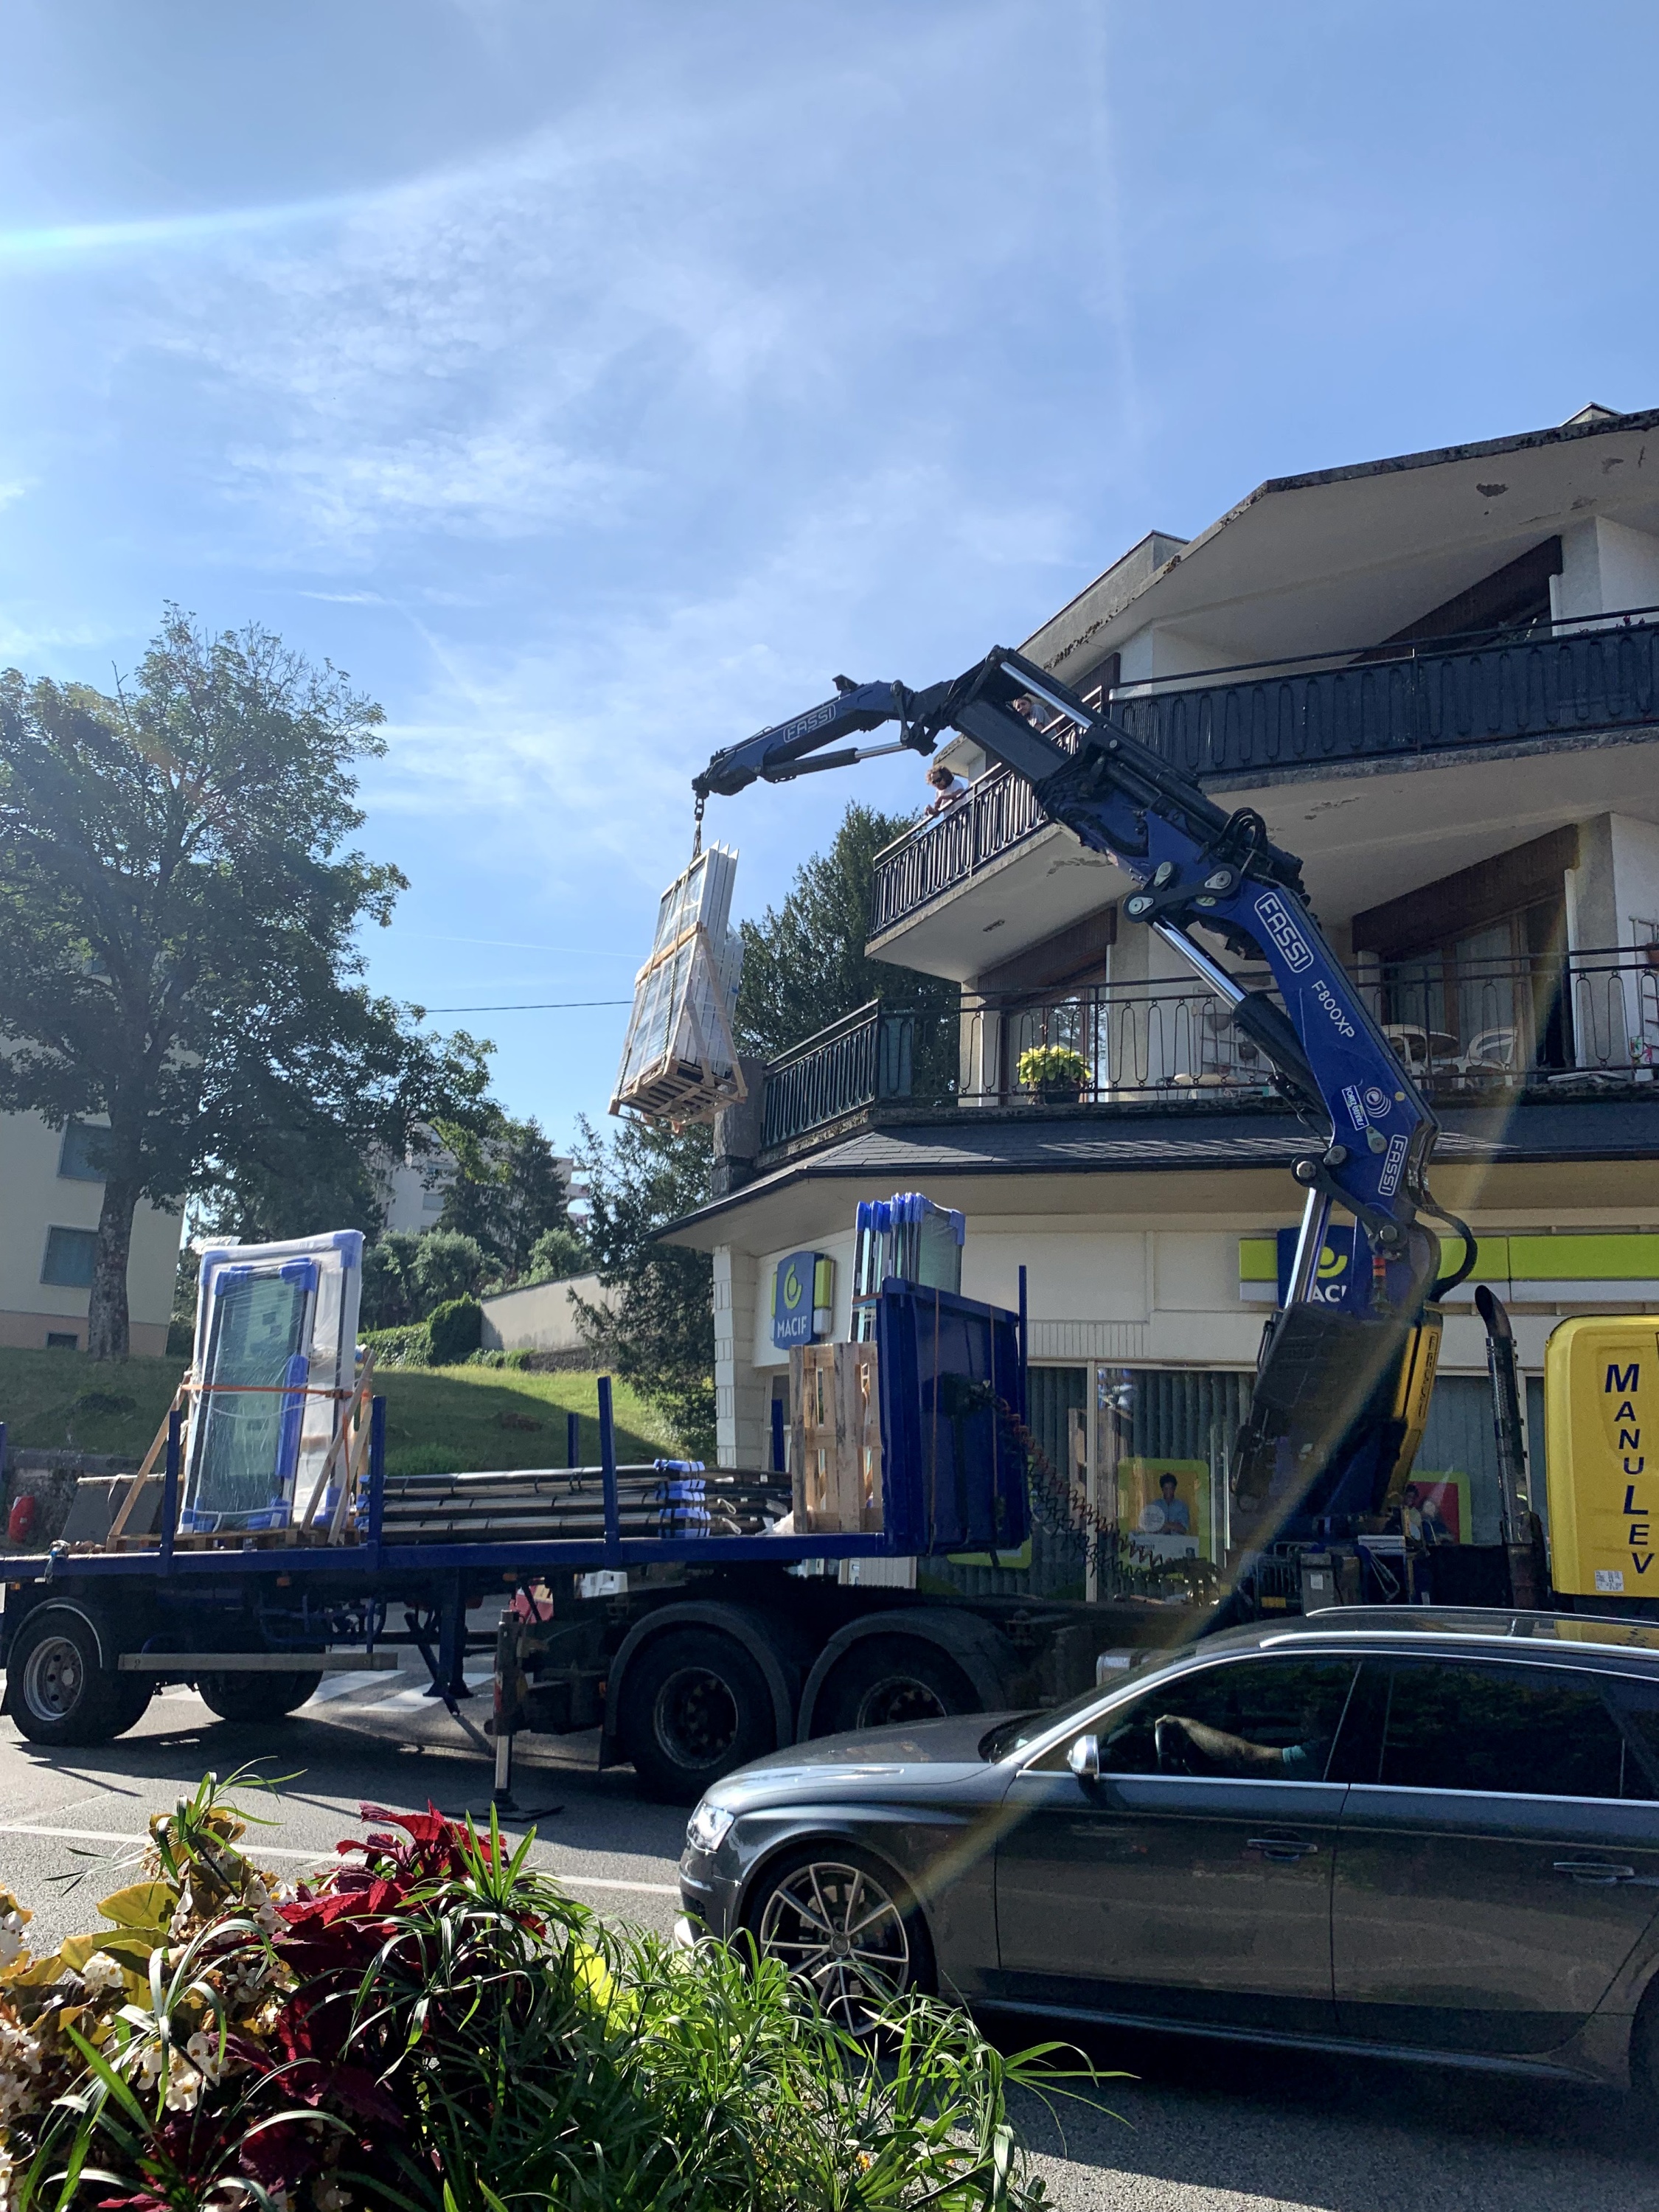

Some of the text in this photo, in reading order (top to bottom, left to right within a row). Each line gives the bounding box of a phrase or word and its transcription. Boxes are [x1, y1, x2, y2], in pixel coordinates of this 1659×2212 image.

[787, 707, 832, 740] FASSI
[1259, 898, 1309, 967] FASSI
[1311, 980, 1355, 1037] F800XP
[1382, 1140, 1404, 1192] FASSI
[1312, 1284, 1347, 1303] ACI
[777, 1315, 807, 1338] MACIF
[1604, 1363, 1655, 1574] MANULEV
